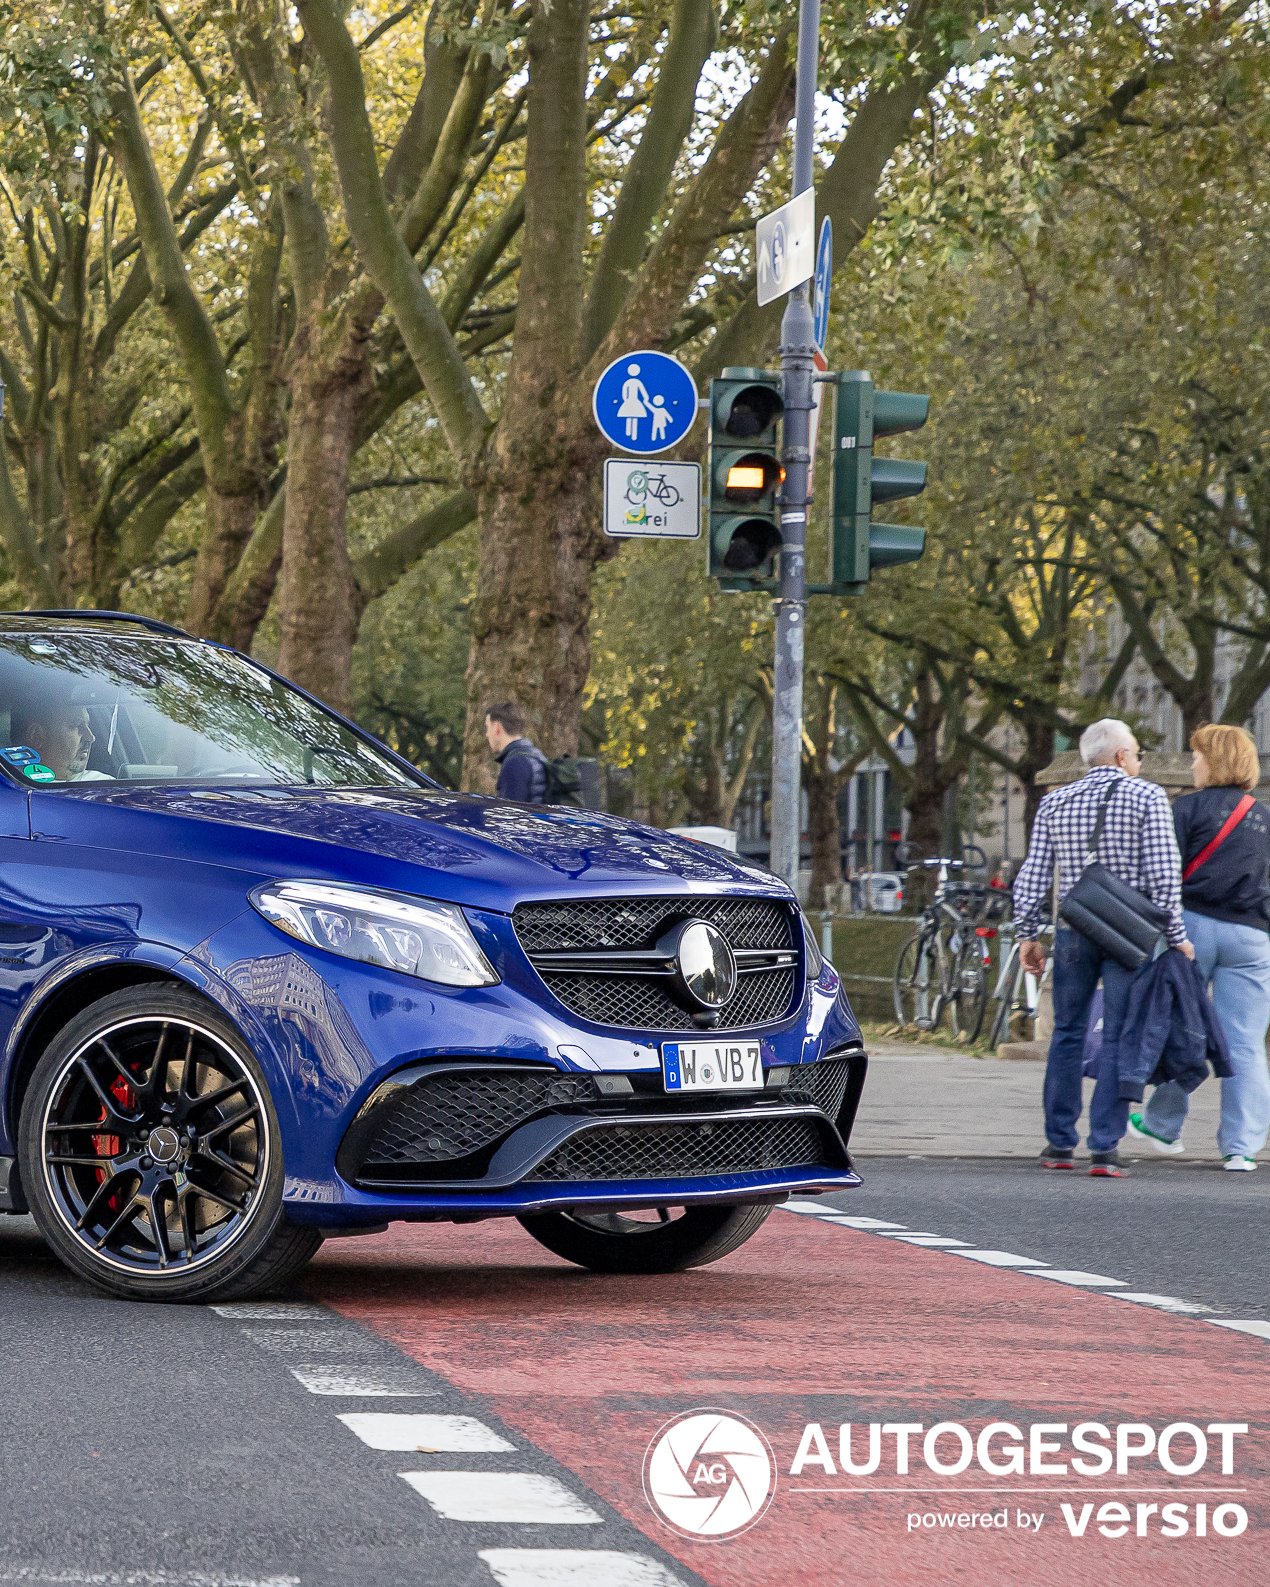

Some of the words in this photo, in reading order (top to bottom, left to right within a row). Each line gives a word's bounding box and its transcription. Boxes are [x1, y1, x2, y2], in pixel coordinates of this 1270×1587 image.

[640, 511, 668, 527] rei
[680, 1050, 696, 1084] W
[670, 1072, 677, 1082] D
